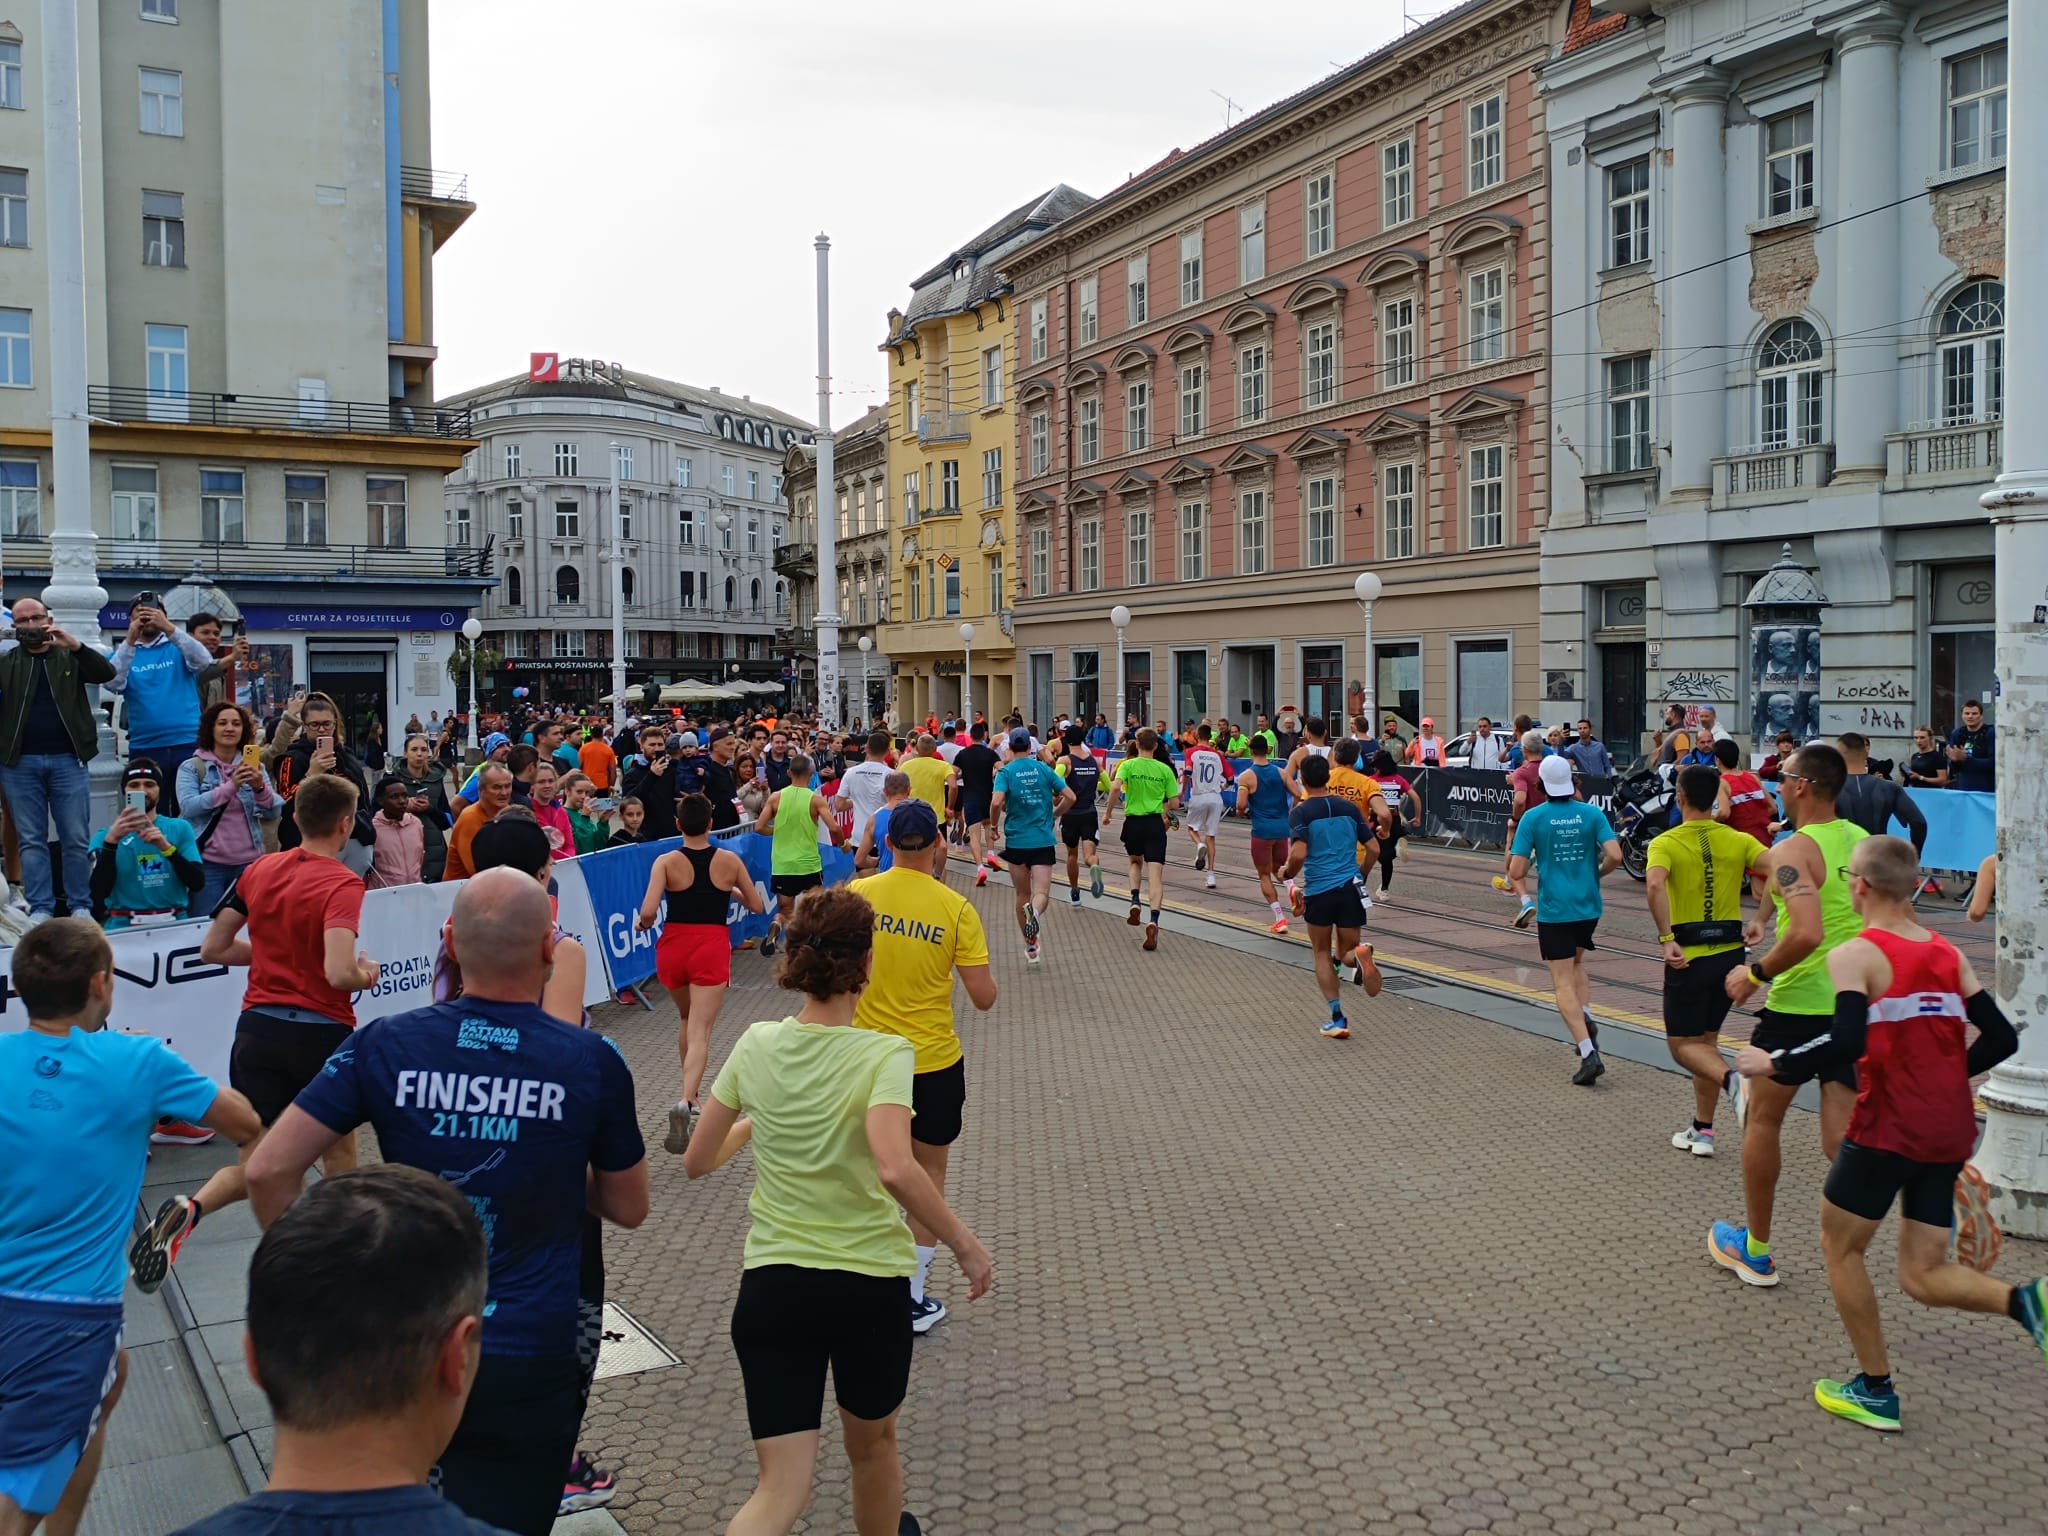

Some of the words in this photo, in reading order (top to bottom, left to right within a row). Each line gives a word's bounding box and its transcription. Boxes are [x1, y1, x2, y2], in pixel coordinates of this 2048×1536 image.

[567, 358, 624, 381] HPB
[109, 612, 129, 620] VIS
[288, 614, 326, 622] CENTAR
[346, 615, 411, 623] POSJETITELJE
[131, 660, 175, 673] GARMIN
[555, 660, 605, 669] POŠTANSKA
[1837, 680, 1909, 699] KOKOŠJA
[1861, 707, 1905, 730] JAJA
[1200, 762, 1215, 784] 10
[1447, 785, 1515, 804] AUTOHRVAT
[379, 955, 431, 979] ROATIA
[460, 1022, 519, 1040] PATTAYA
[456, 1038, 489, 1050] 2024
[395, 1069, 566, 1121] FINISHER
[430, 1112, 518, 1142] 21.1KM
